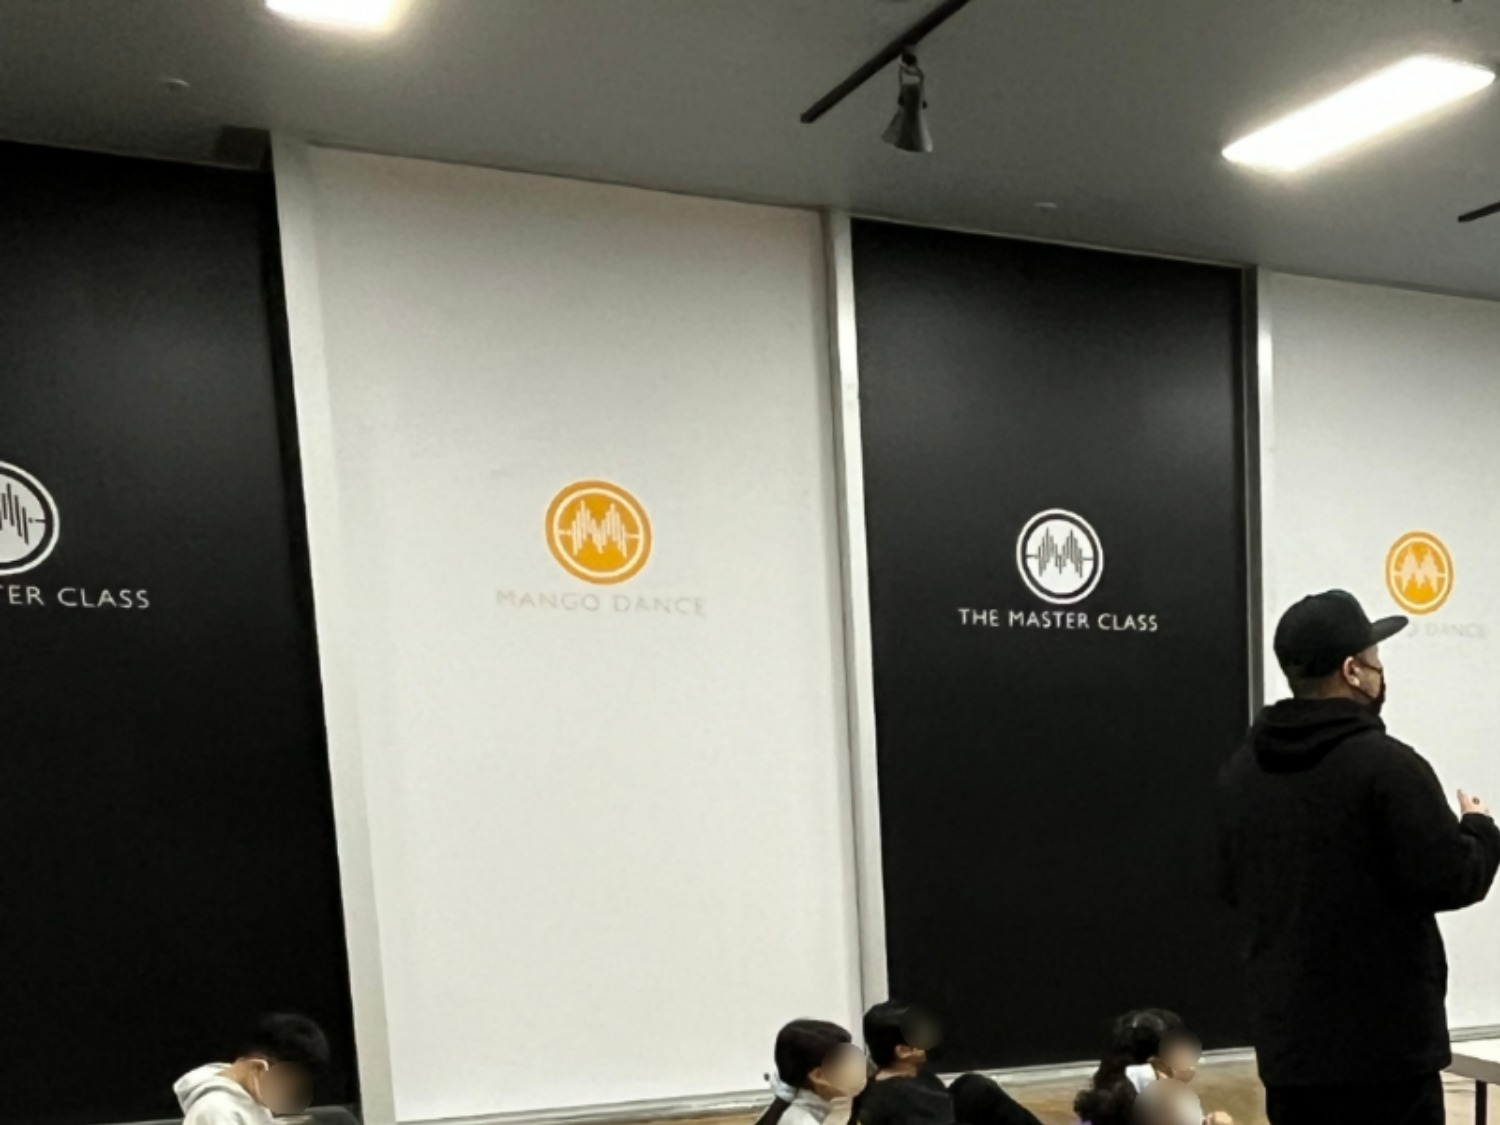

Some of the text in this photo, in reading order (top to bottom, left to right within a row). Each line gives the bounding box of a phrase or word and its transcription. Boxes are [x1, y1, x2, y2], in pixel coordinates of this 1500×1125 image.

[0, 584, 150, 609] ER CLASS
[496, 590, 706, 616] MANGO DANCE
[958, 608, 1158, 632] THE MASTER CLASS
